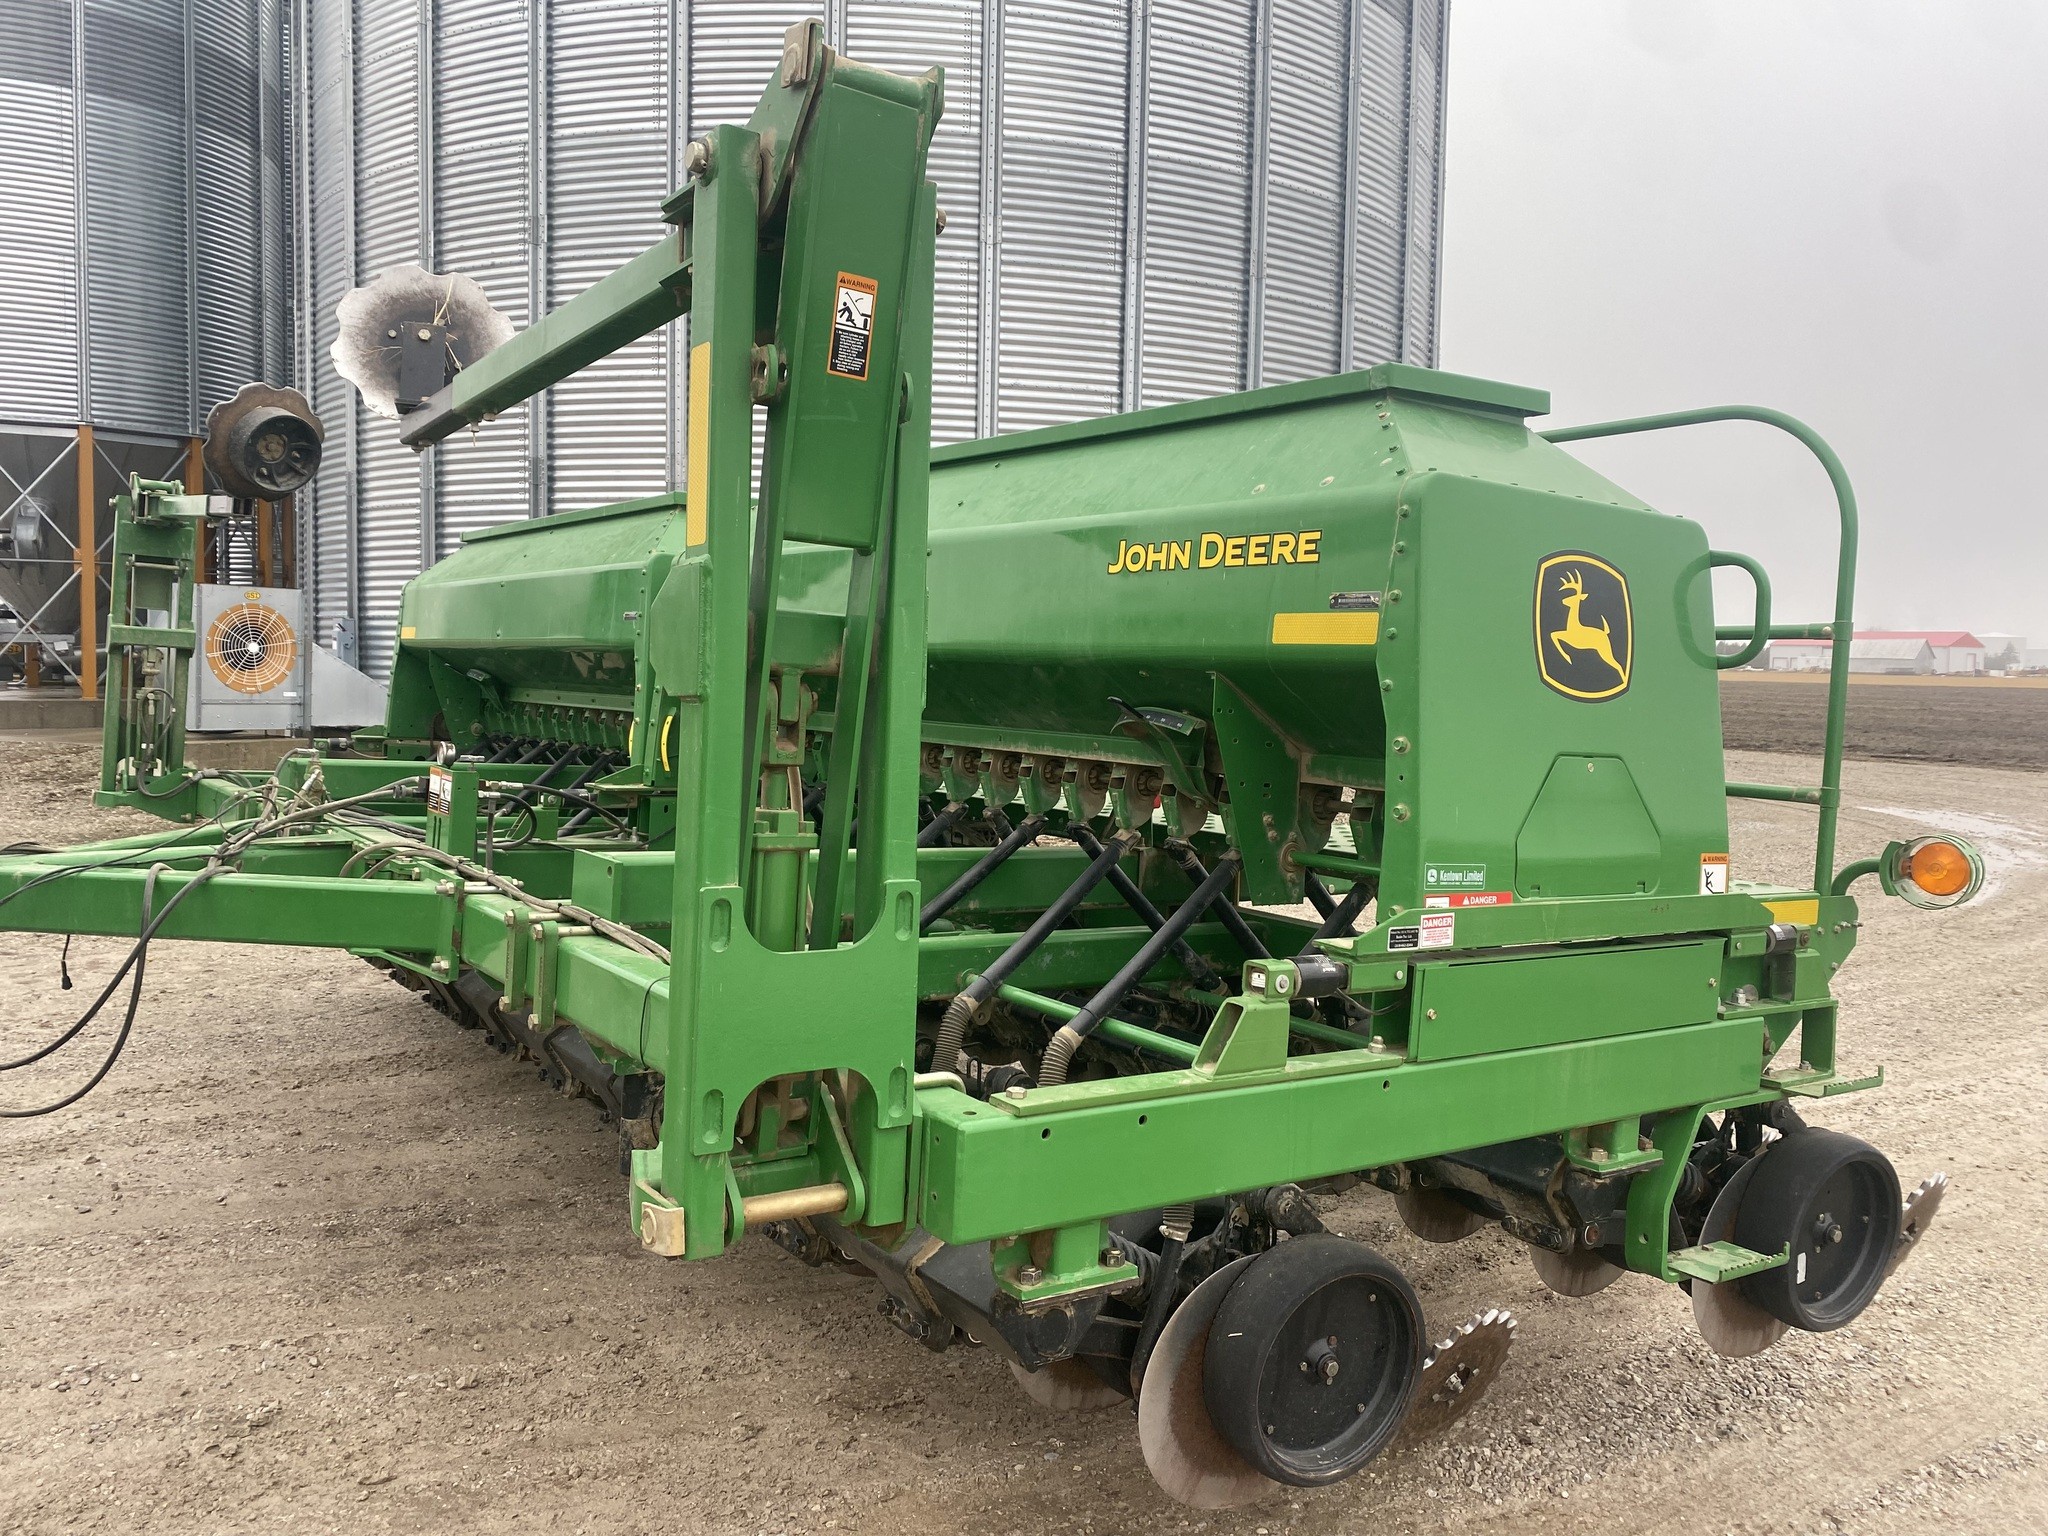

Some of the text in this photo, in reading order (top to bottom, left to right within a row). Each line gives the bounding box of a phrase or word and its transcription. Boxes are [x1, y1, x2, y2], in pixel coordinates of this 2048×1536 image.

[846, 279, 875, 291] WARNING
[1107, 529, 1323, 575] JOHN DEERE
[1463, 870, 1483, 881] Limited
[1470, 895, 1498, 905] DANGER
[1423, 917, 1453, 928] DANGER
